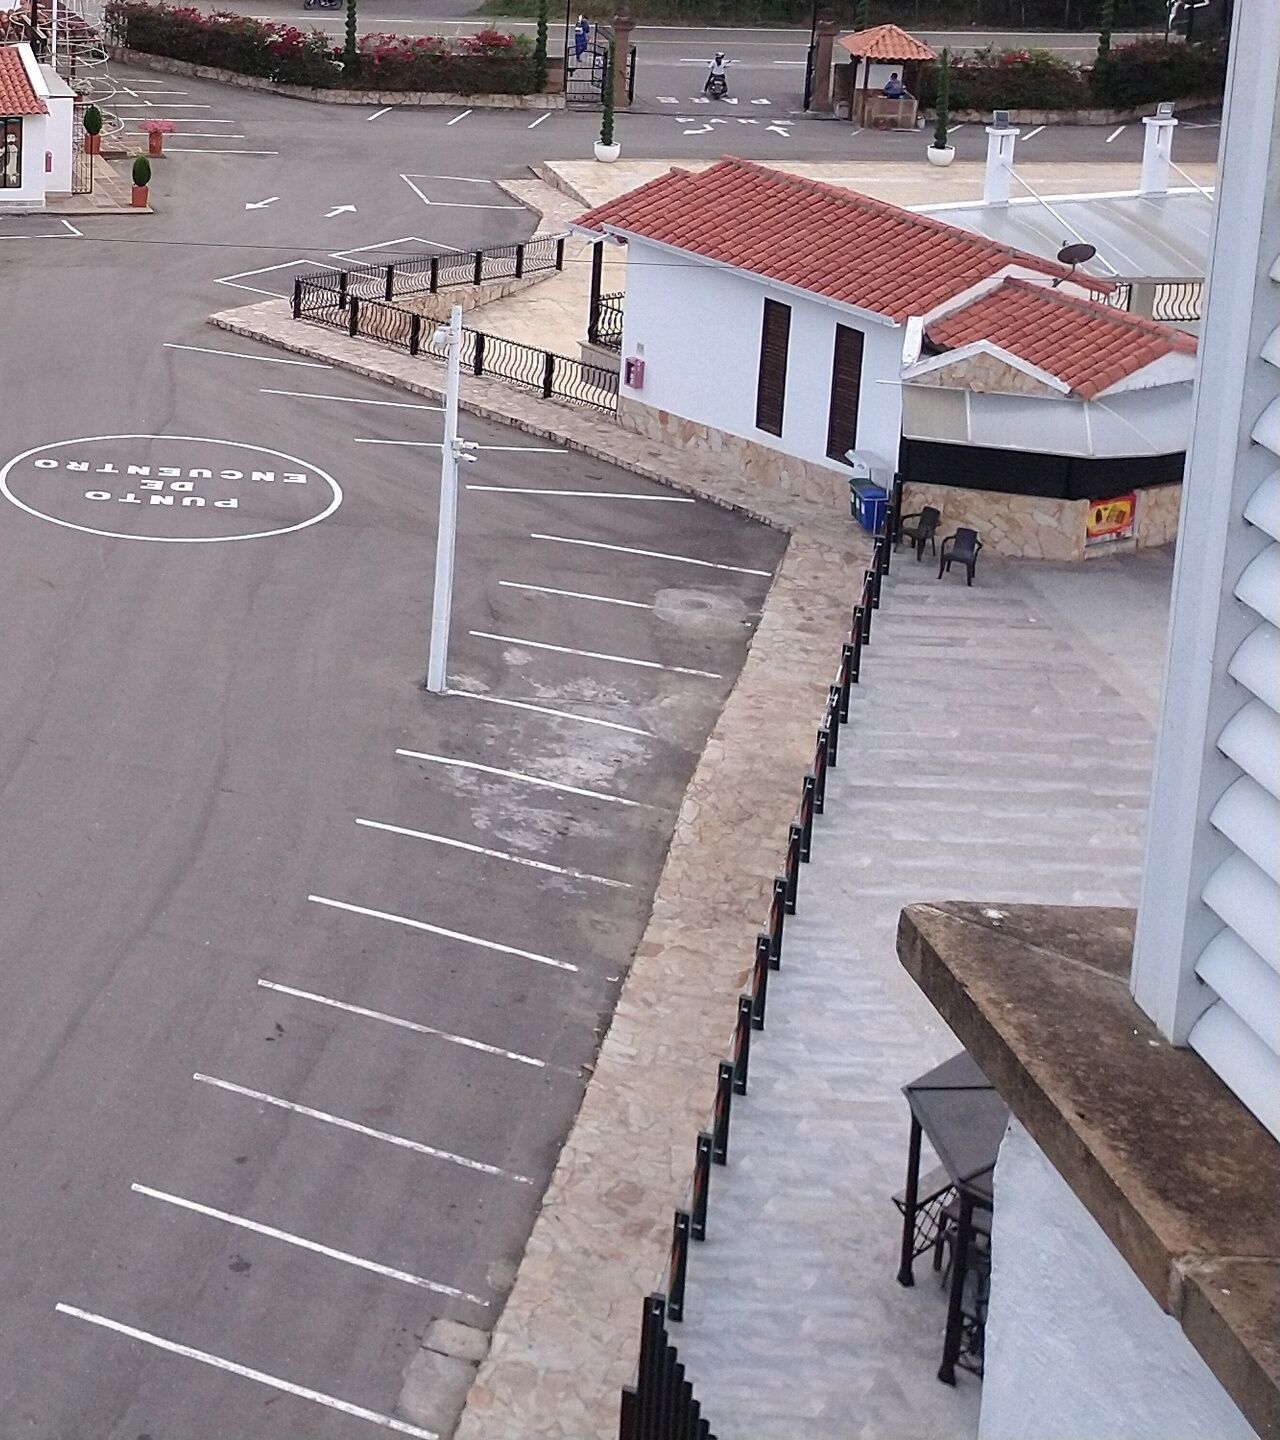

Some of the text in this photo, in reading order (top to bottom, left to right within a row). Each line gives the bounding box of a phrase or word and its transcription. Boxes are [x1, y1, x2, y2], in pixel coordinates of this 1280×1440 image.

[656, 96, 772, 105] PARE
[34, 459, 308, 484] ENCUENTRO
[140, 479, 194, 492] DE
[85, 491, 239, 508] PUNTO
